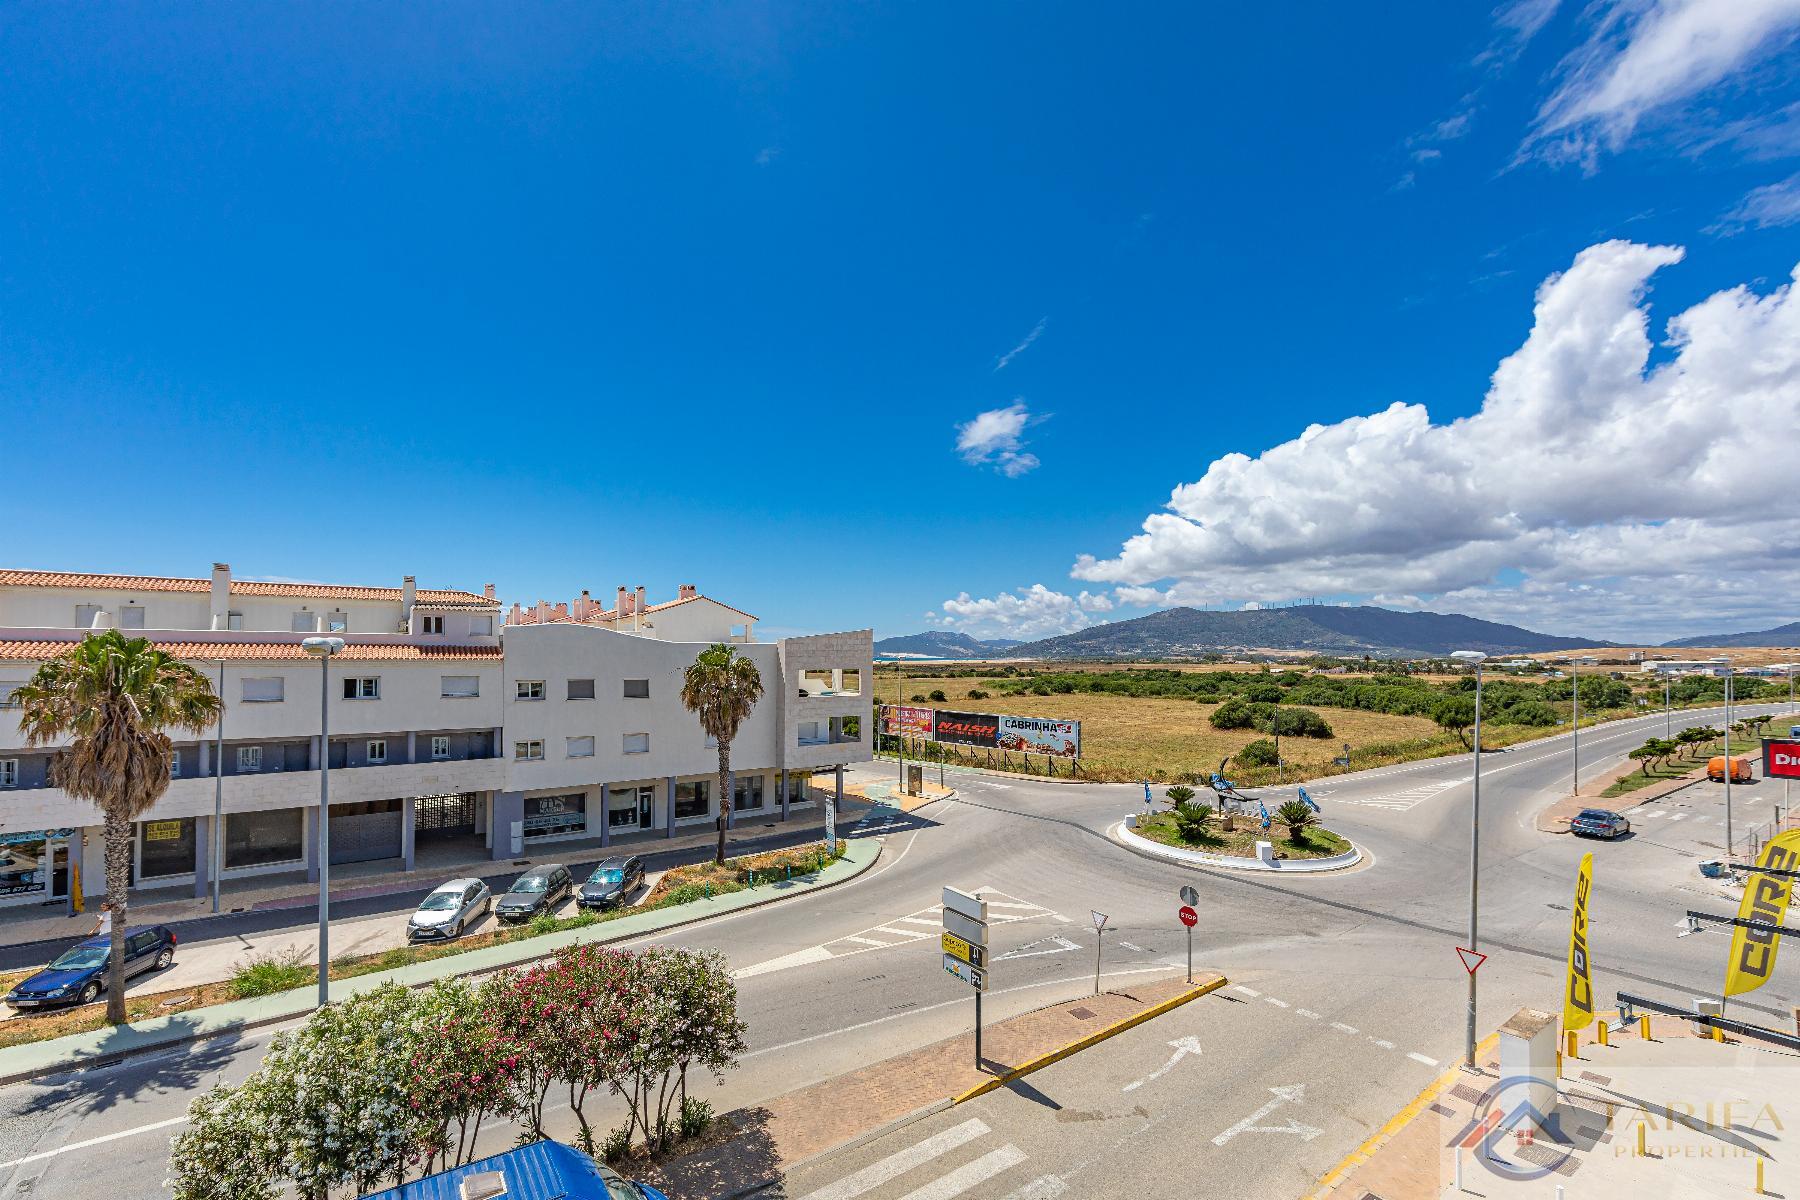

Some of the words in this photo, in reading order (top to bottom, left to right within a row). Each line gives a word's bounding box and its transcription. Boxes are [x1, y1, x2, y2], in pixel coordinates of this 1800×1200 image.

[937, 721, 997, 734] NAISH
[1005, 719, 1058, 734] CABRINHA
[1775, 753, 1800, 766] DI
[1180, 911, 1197, 921] STOP
[1740, 845, 1797, 978] CORE
[1570, 870, 1592, 1013] CORE
